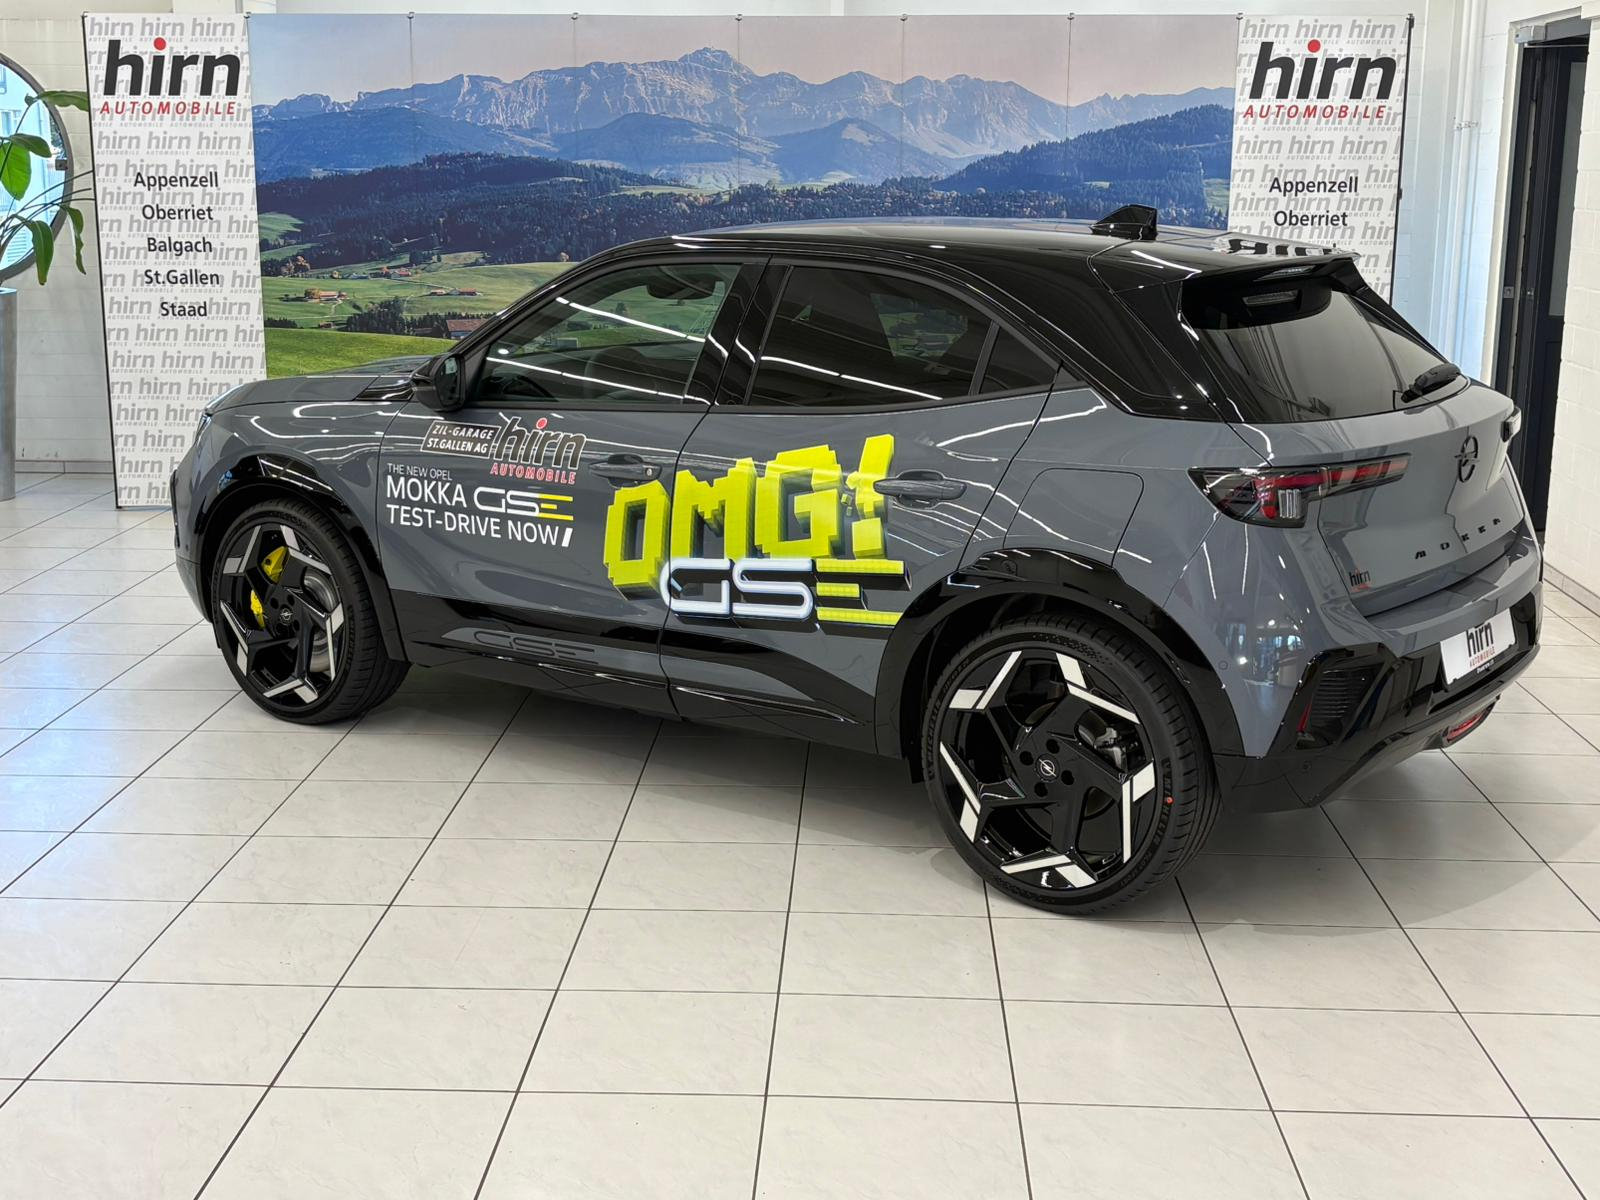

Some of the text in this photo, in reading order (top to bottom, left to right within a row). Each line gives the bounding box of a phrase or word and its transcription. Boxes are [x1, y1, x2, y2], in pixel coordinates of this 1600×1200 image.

[90, 17, 133, 36] hirn
[141, 17, 184, 36] hirn
[191, 17, 235, 36] hirn
[1243, 19, 1395, 38] hirn hirn hirn
[104, 37, 240, 96] hirn
[1250, 39, 1396, 99] hirn
[100, 102, 235, 114] AUTOMOBILE
[1243, 105, 1386, 118] AUTOMOBILE
[98, 131, 241, 149] hirn hirn hirn
[1236, 135, 1387, 154] hirn hirn hirn
[96, 164, 118, 176] rn
[225, 160, 253, 177] hir
[1233, 169, 1254, 182] rn
[1365, 165, 1398, 182] hir
[134, 172, 219, 191] Appenzell
[1269, 176, 1358, 196] Appenzell
[102, 187, 144, 204] hirn
[201, 188, 243, 205] hirn
[1233, 193, 1383, 211] hirn hirn hirn
[142, 204, 213, 220] Oberriet
[1274, 210, 1347, 226] Oberriet
[101, 219, 121, 232] rn
[228, 215, 258, 232] hir
[1362, 222, 1394, 239] hir
[105, 242, 148, 259] hirn
[147, 237, 212, 256] Balgach
[104, 274, 125, 286] rn
[231, 270, 260, 287] hir
[144, 269, 219, 285] St.Gallen
[109, 296, 150, 313] hirn
[208, 297, 250, 314] hirn
[160, 301, 207, 317] Staad
[107, 324, 263, 342] rn hirn hirn hir
[112, 351, 254, 368] hirn hirn hirn
[111, 380, 132, 393] rn
[139, 378, 181, 394] hirn
[188, 378, 230, 394] hirn
[116, 404, 158, 420] hirn
[115, 430, 184, 447] rn hirn
[432, 425, 494, 439] ZIL-GARAGE
[427, 438, 488, 453] ST.GALLEN AG
[494, 416, 587, 469] hirn
[121, 457, 162, 472] hirn
[387, 463, 453, 480] THE NEW OPEL
[490, 463, 576, 484] AUTOMOBILE
[119, 485, 140, 498] rn
[387, 475, 573, 520] MOKKA GSE
[387, 504, 501, 538] TEST-DRIVE
[603, 434, 894, 593] OMG!
[1349, 567, 1371, 587] hirn
[660, 558, 907, 631] GSE
[474, 631, 599, 664] GSE
[1465, 622, 1494, 657] hirn
